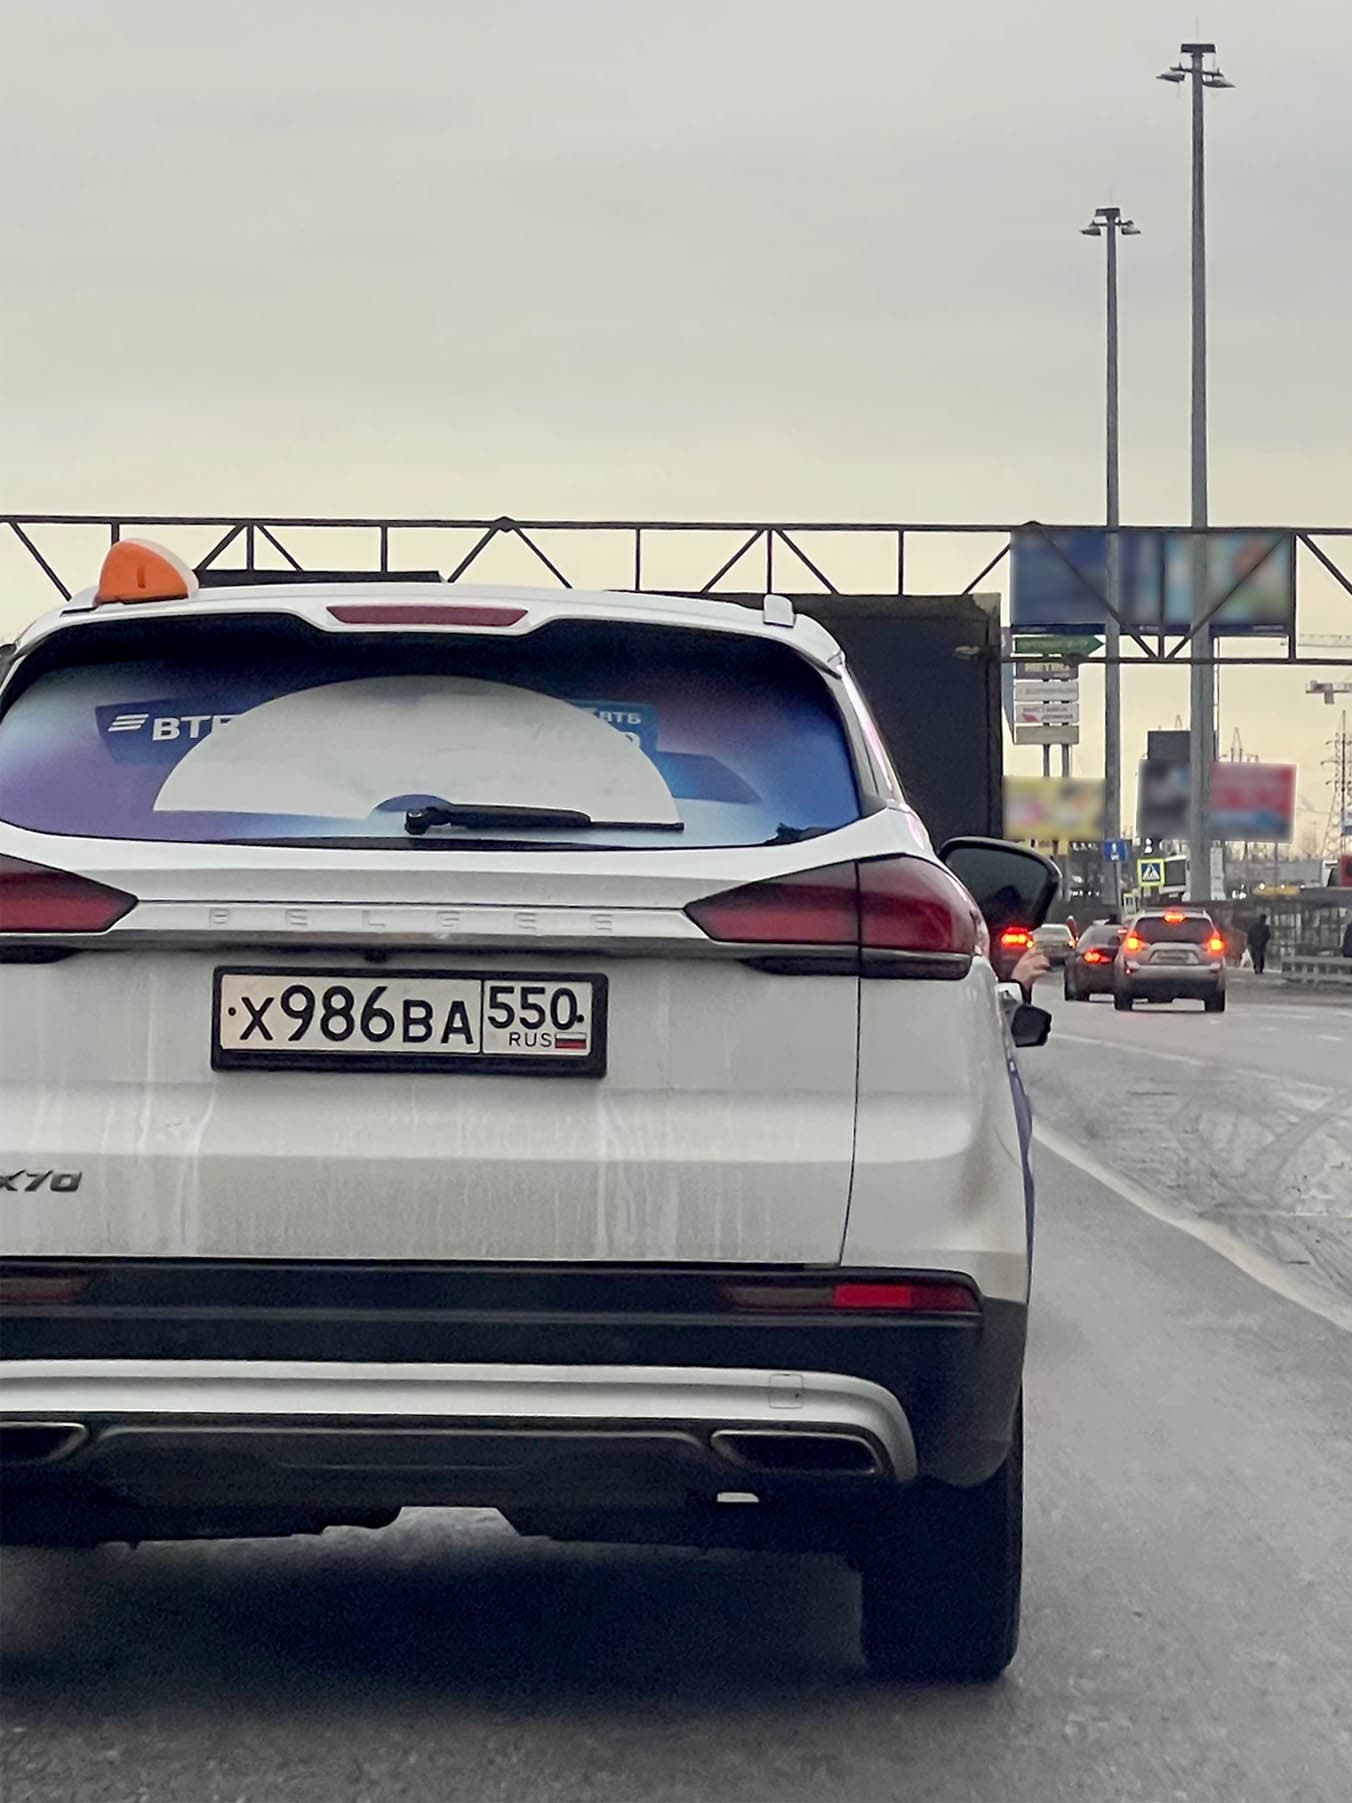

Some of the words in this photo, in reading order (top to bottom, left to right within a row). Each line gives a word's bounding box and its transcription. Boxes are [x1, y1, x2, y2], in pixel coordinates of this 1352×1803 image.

[239, 984, 474, 1046] Х986ВА
[487, 986, 579, 1031] 550
[508, 1032, 553, 1049] RUS
